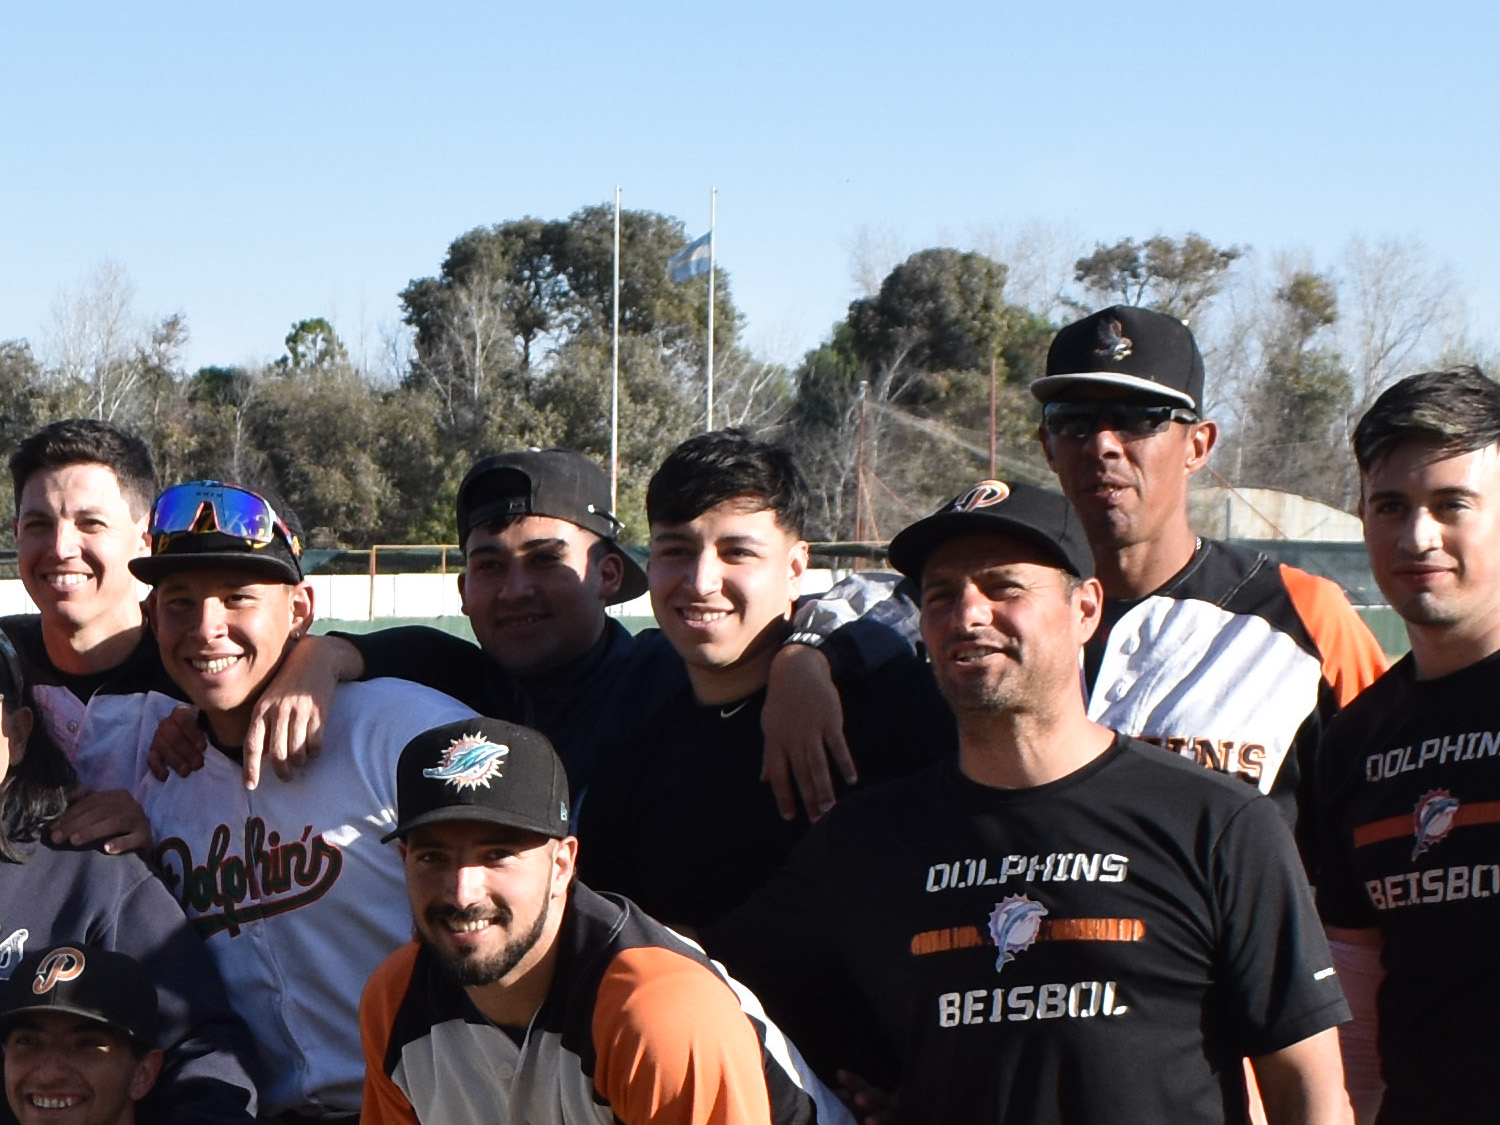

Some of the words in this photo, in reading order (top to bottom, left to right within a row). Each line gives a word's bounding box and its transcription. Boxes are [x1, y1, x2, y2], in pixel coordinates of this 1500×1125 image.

[926, 852, 1129, 892] DOLPHINS
[32, 946, 86, 995] P
[938, 980, 1130, 1028] BEISBOL
